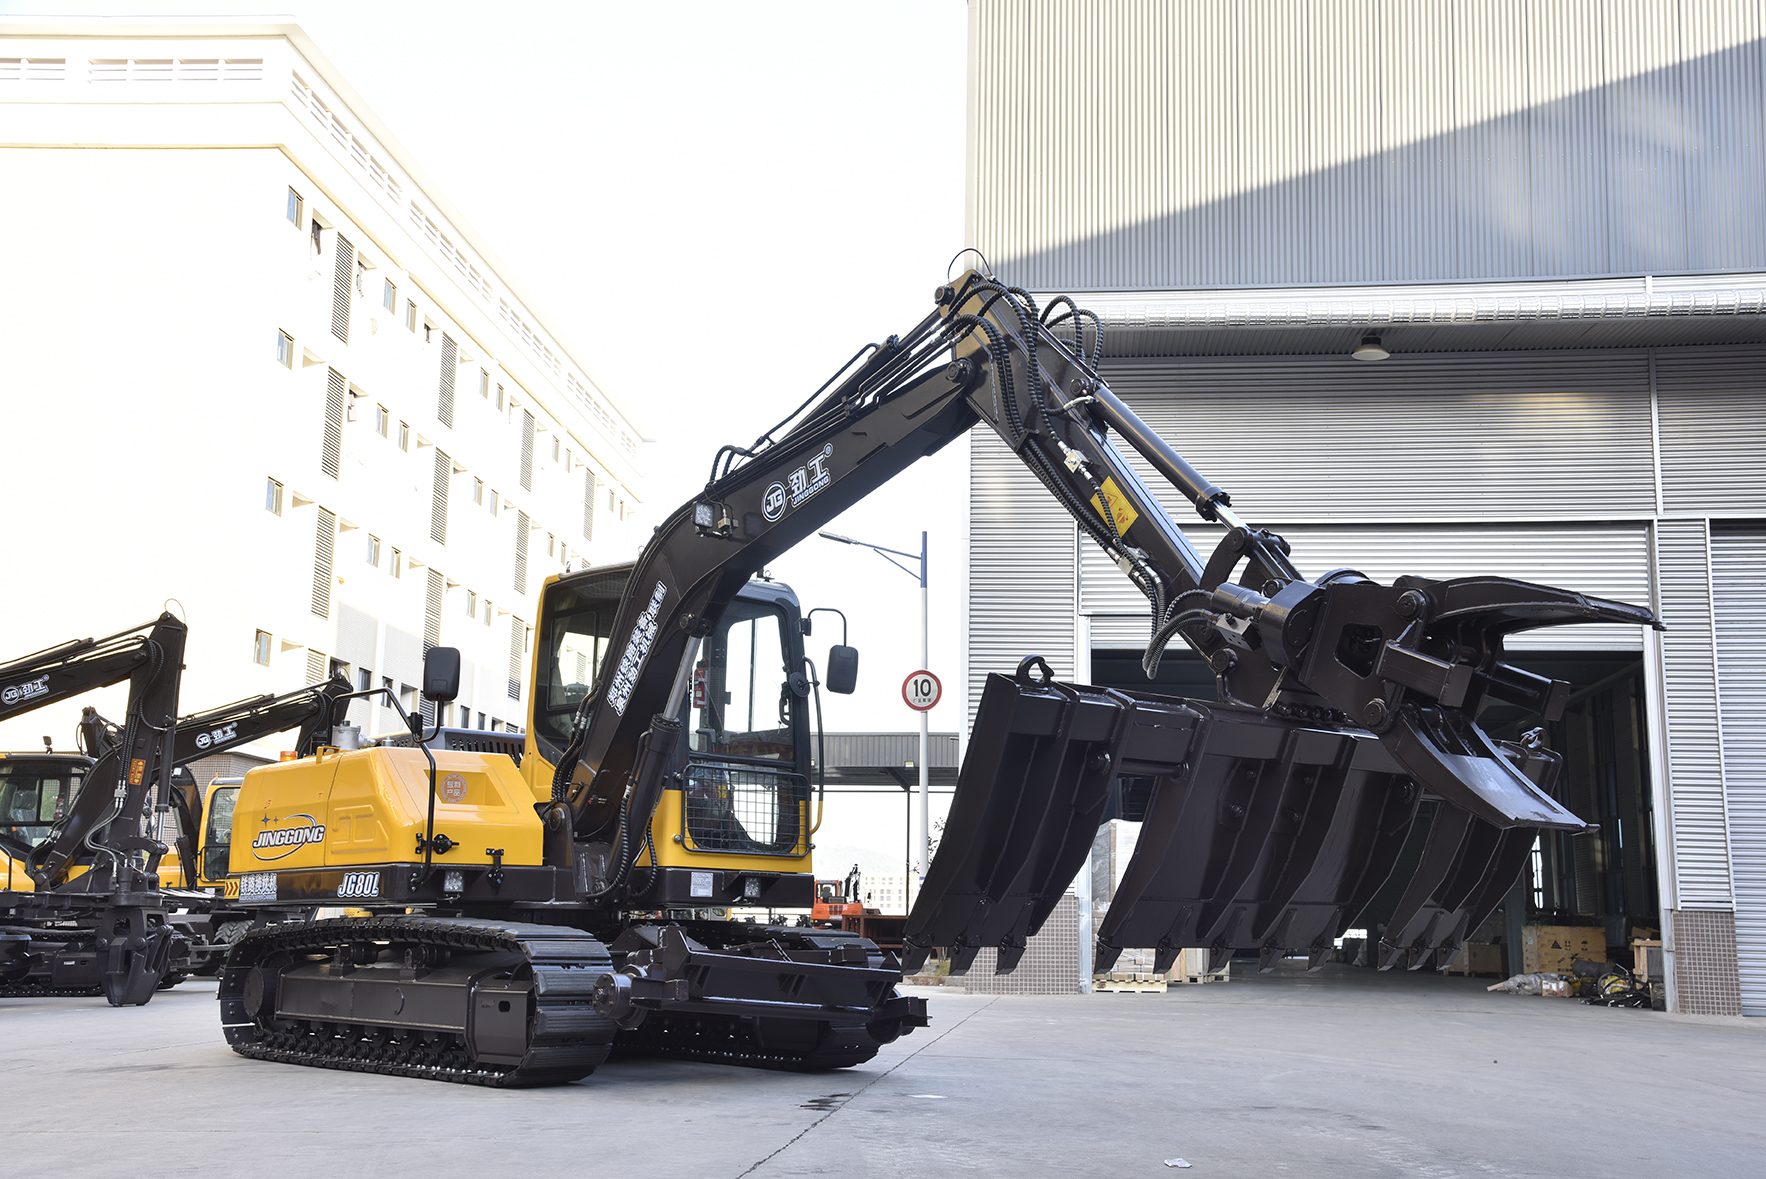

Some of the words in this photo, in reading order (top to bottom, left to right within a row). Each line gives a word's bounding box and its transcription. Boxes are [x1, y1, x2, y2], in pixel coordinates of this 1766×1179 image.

[766, 489, 784, 513] JG
[793, 476, 830, 505] JINGGONG
[5, 690, 18, 700] JG
[914, 679, 931, 697] 10
[253, 825, 325, 848] JINGGONG
[338, 872, 380, 897] JG80L
